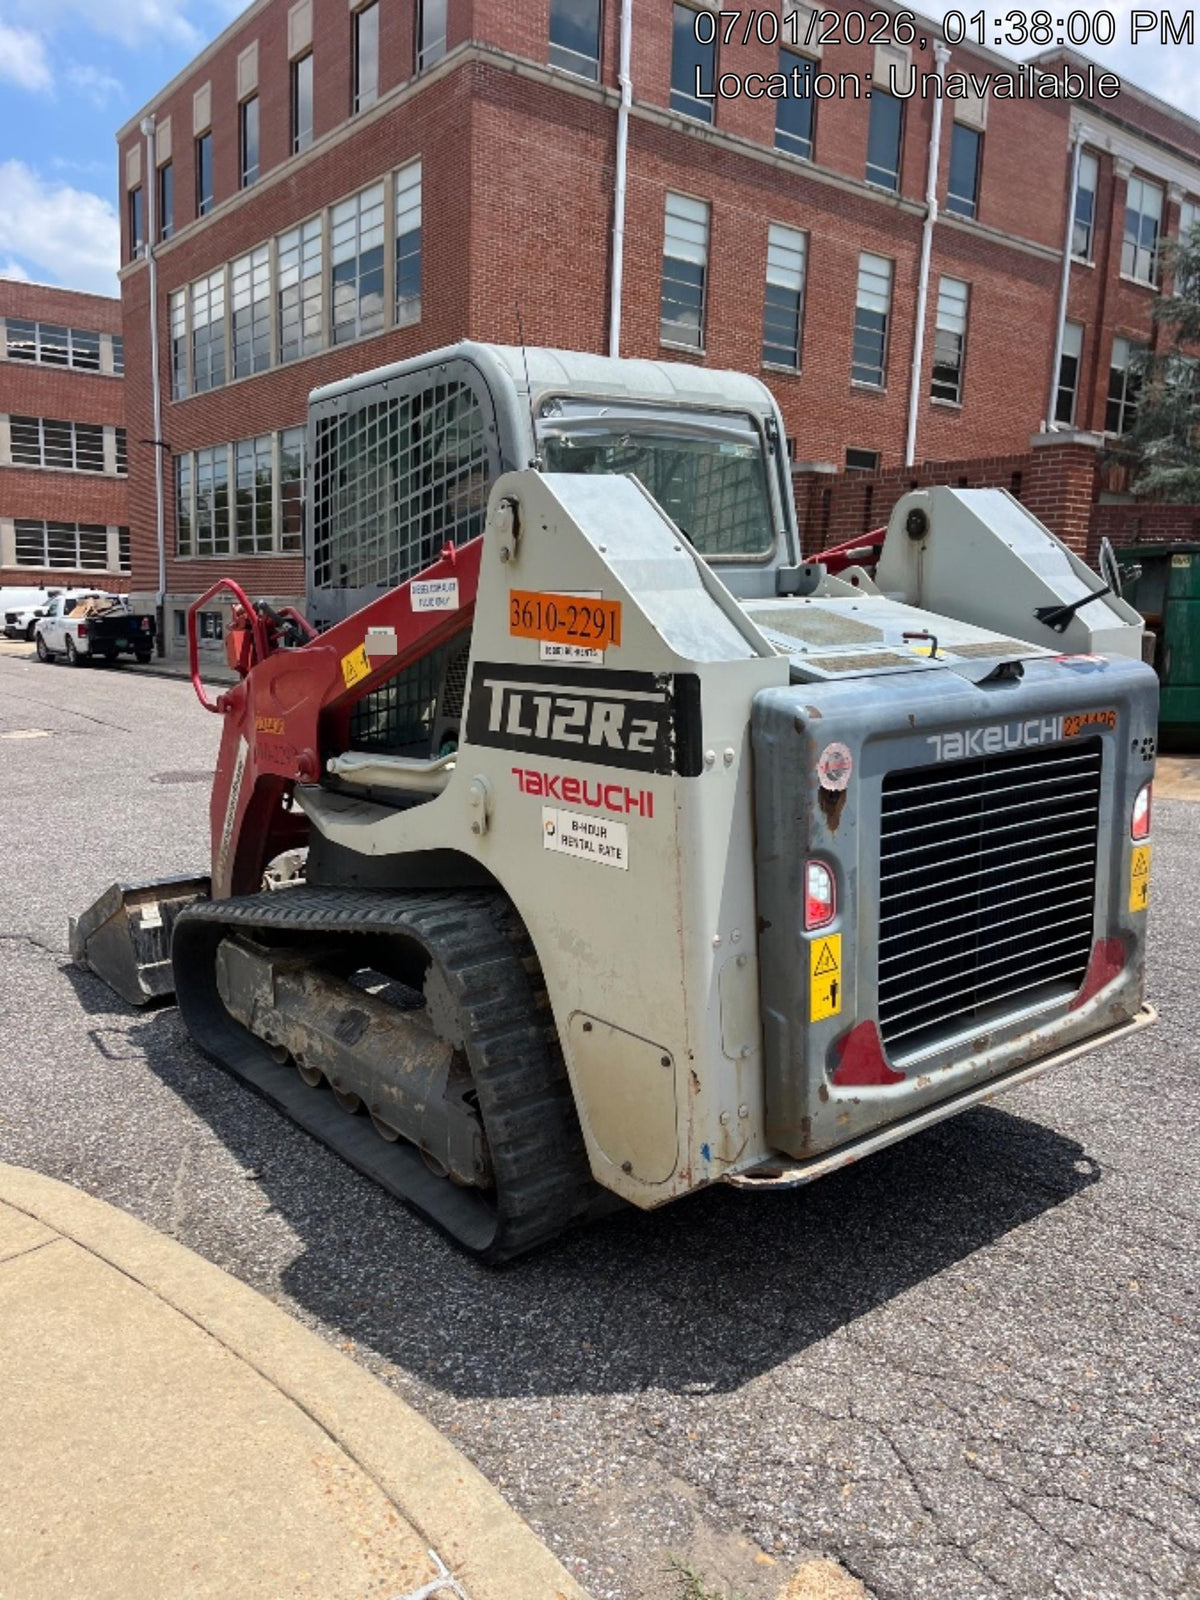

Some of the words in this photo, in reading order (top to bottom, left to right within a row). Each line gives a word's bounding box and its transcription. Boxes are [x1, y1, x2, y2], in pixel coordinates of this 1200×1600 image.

[510, 598, 617, 644] 3610-2291
[483, 678, 667, 753] TL12R2
[927, 716, 1064, 760] TAKEUCHI
[511, 767, 654, 819] TAKEUCHI
[561, 834, 595, 853] RENTAL
[598, 843, 623, 859] RATE
